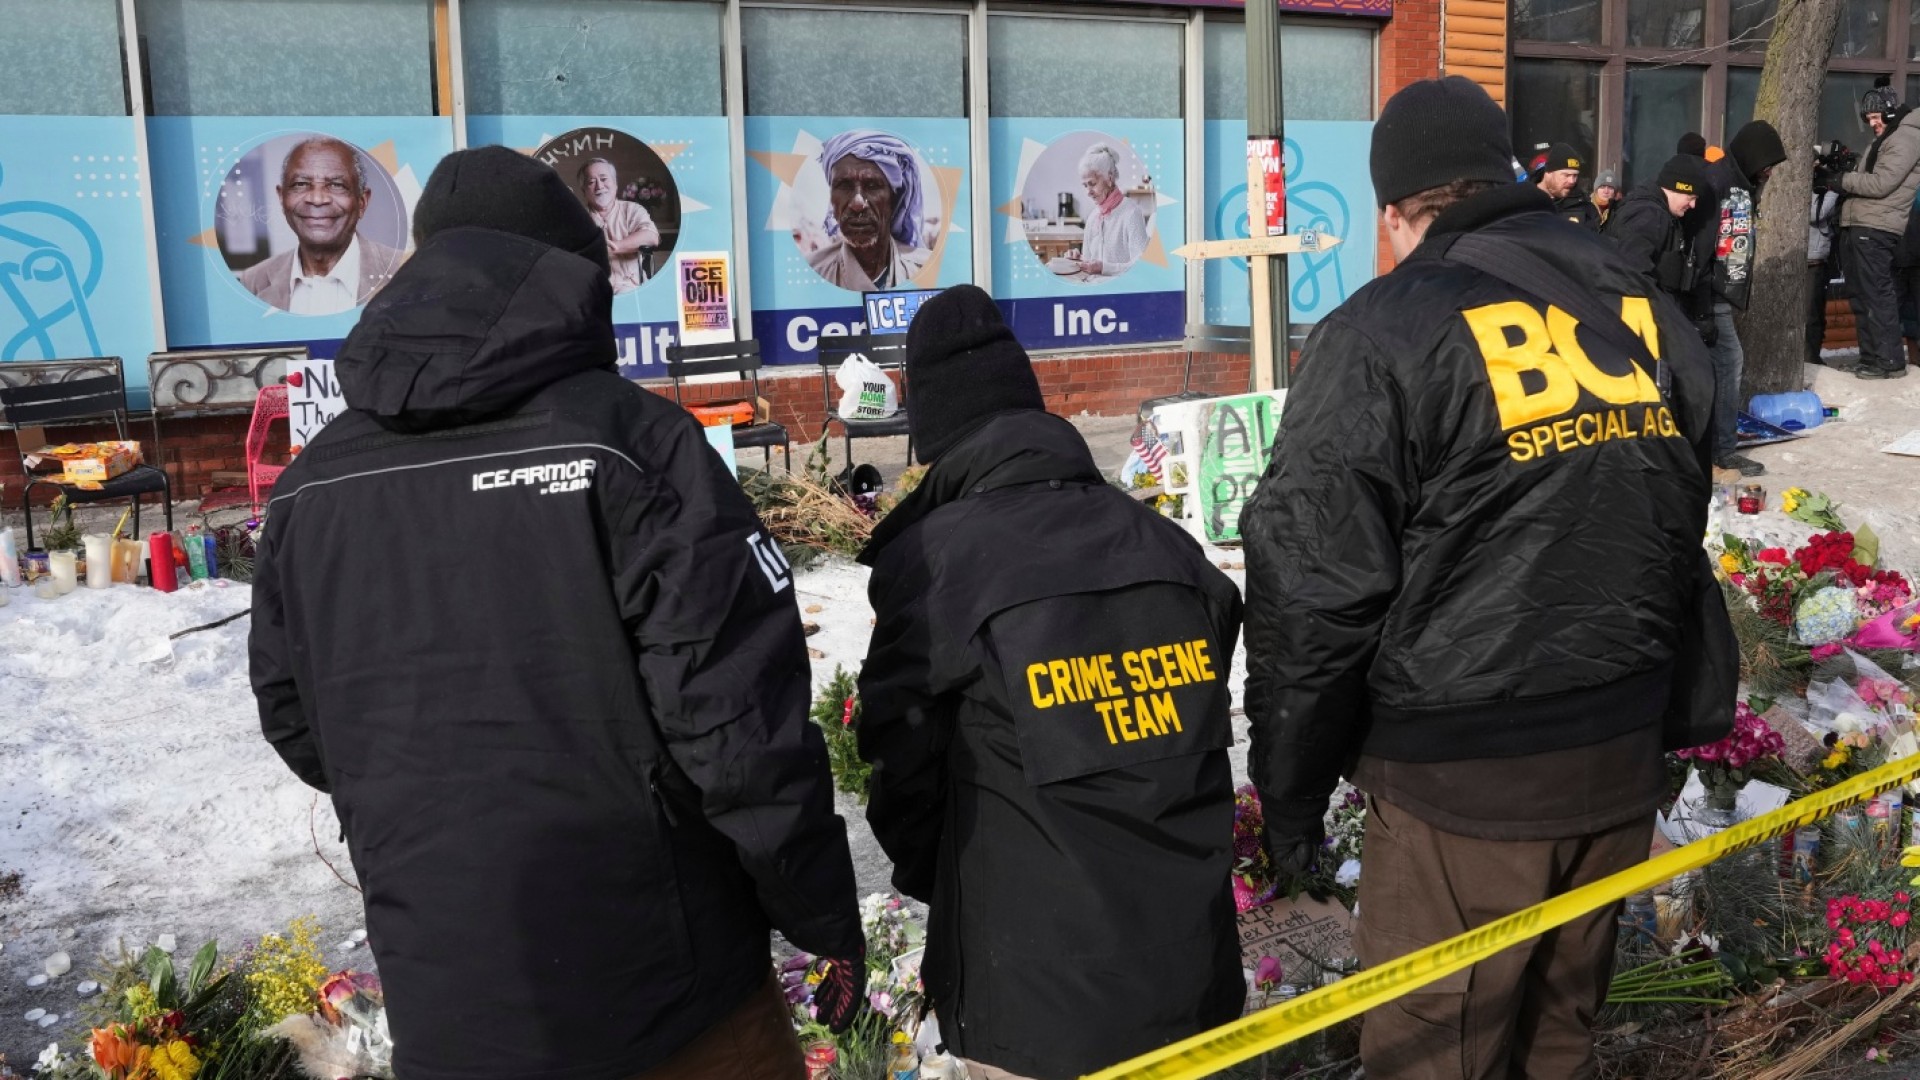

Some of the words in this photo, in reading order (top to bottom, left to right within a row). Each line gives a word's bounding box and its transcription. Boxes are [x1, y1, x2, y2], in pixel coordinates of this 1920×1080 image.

[685, 266, 723, 281] ICE
[686, 281, 724, 304] OUT!
[868, 297, 908, 329] ICE
[1053, 303, 1129, 336] Inc.
[1461, 296, 1662, 431] BCA
[860, 391, 887, 403] HOME
[863, 381, 887, 393] YOUR
[1507, 409, 1637, 462] SPECIAL
[1643, 406, 1682, 438] AG
[1026, 653, 1124, 709] CRIME
[1121, 639, 1217, 693] SCENE
[1094, 691, 1183, 745] TEAM
[1237, 904, 1274, 927] RIP
[1263, 909, 1313, 933] Pretti
